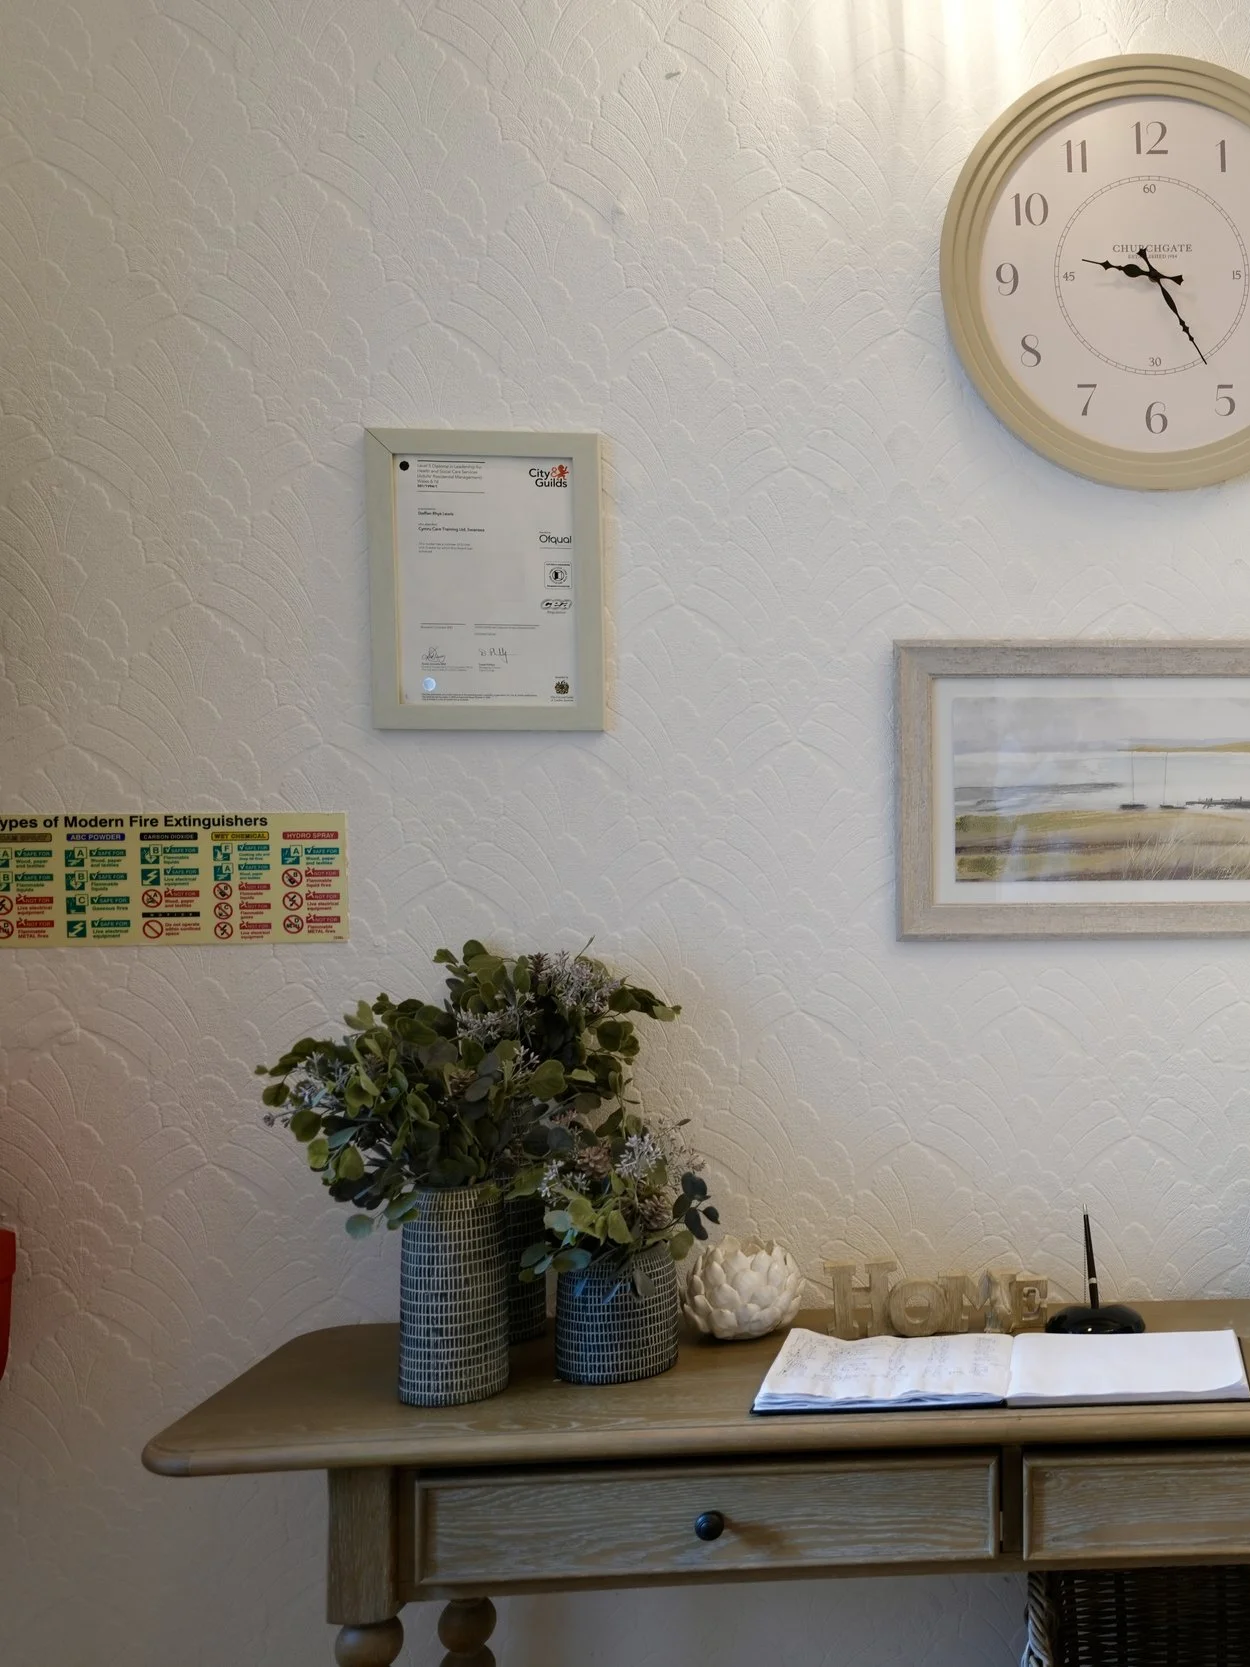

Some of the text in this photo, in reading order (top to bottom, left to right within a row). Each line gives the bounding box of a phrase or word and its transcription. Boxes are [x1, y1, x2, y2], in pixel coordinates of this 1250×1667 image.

[1130, 121, 1169, 155] 12
[1062, 140, 1087, 173] 11
[1216, 139, 1227, 173] 1
[1143, 183, 1156, 194] 60
[1010, 192, 1049, 226] 10
[995, 262, 1020, 297] 9
[1062, 271, 1076, 282] 45
[1231, 269, 1242, 280] 15
[1020, 334, 1041, 368] 8
[1148, 356, 1161, 367] 30
[1076, 383, 1097, 416] 7
[1214, 383, 1236, 416] 5
[1145, 401, 1168, 435] 6
[528, 468, 550, 480] City
[535, 478, 568, 488] Guilds
[539, 534, 572, 545] Ofqual
[0, 815, 268, 831] ypes of Modern Fire Extinguishers
